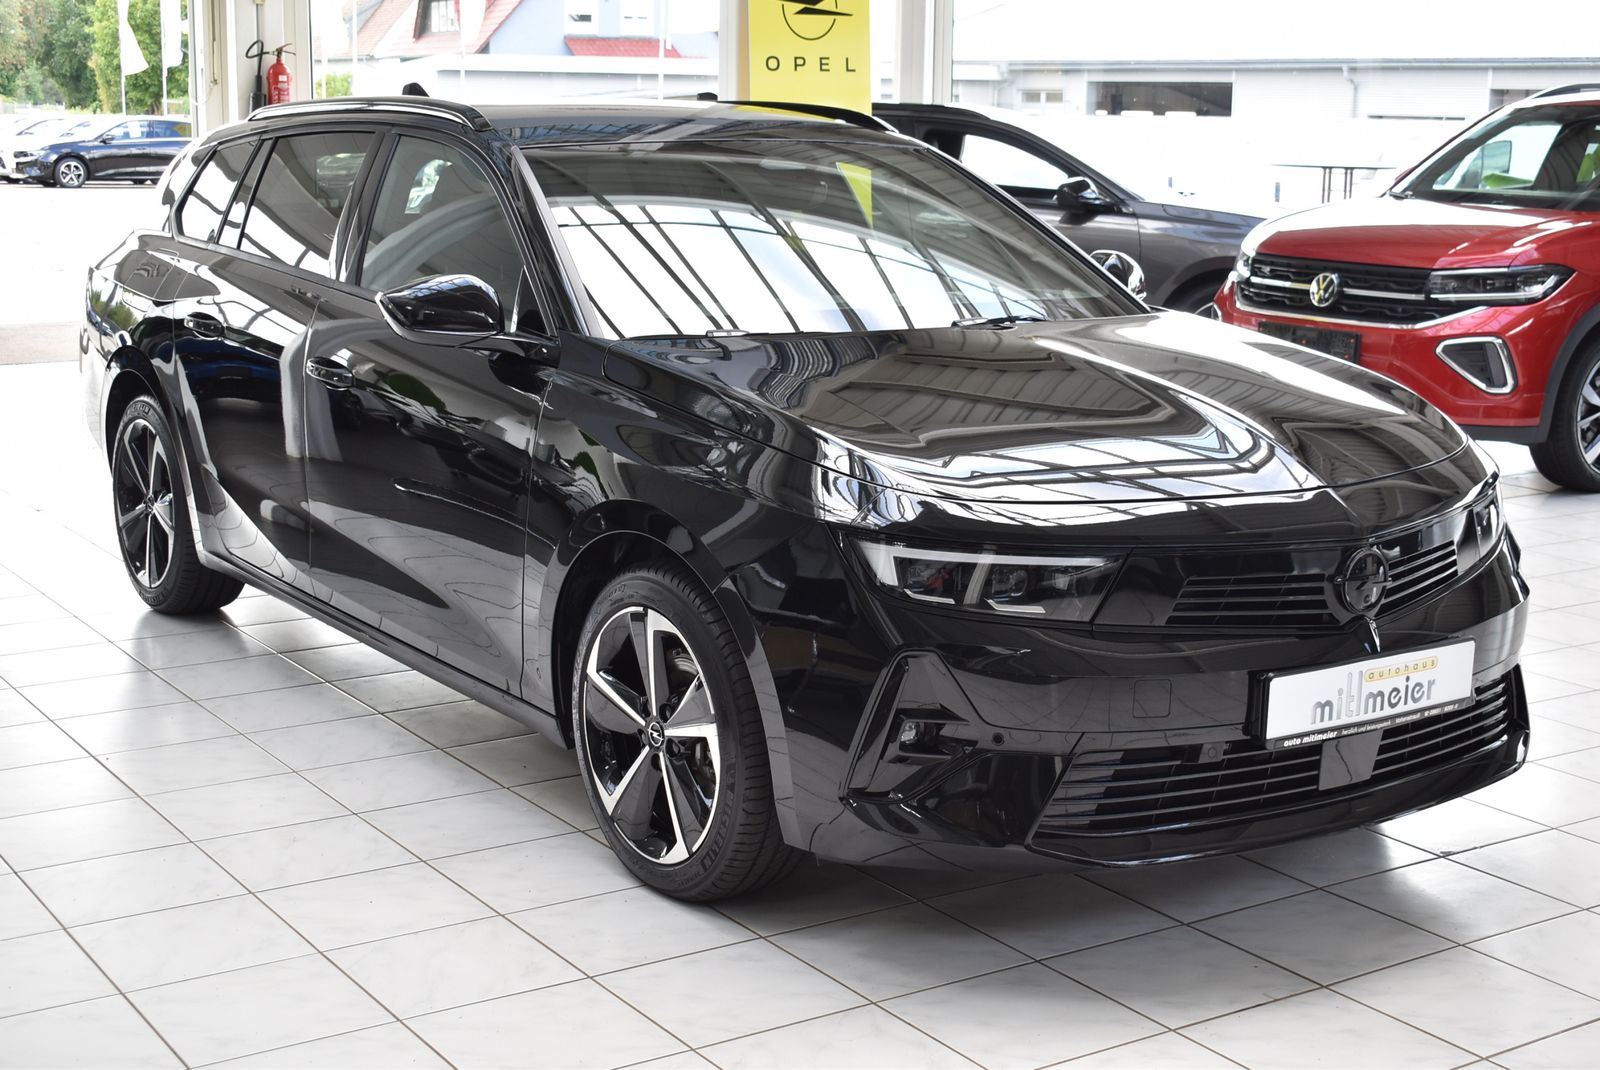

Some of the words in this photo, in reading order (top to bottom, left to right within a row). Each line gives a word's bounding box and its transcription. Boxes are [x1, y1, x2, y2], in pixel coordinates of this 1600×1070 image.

[765, 55, 856, 72] OPEL
[1368, 659, 1436, 680] autohaus
[1283, 738, 1301, 747] auto
